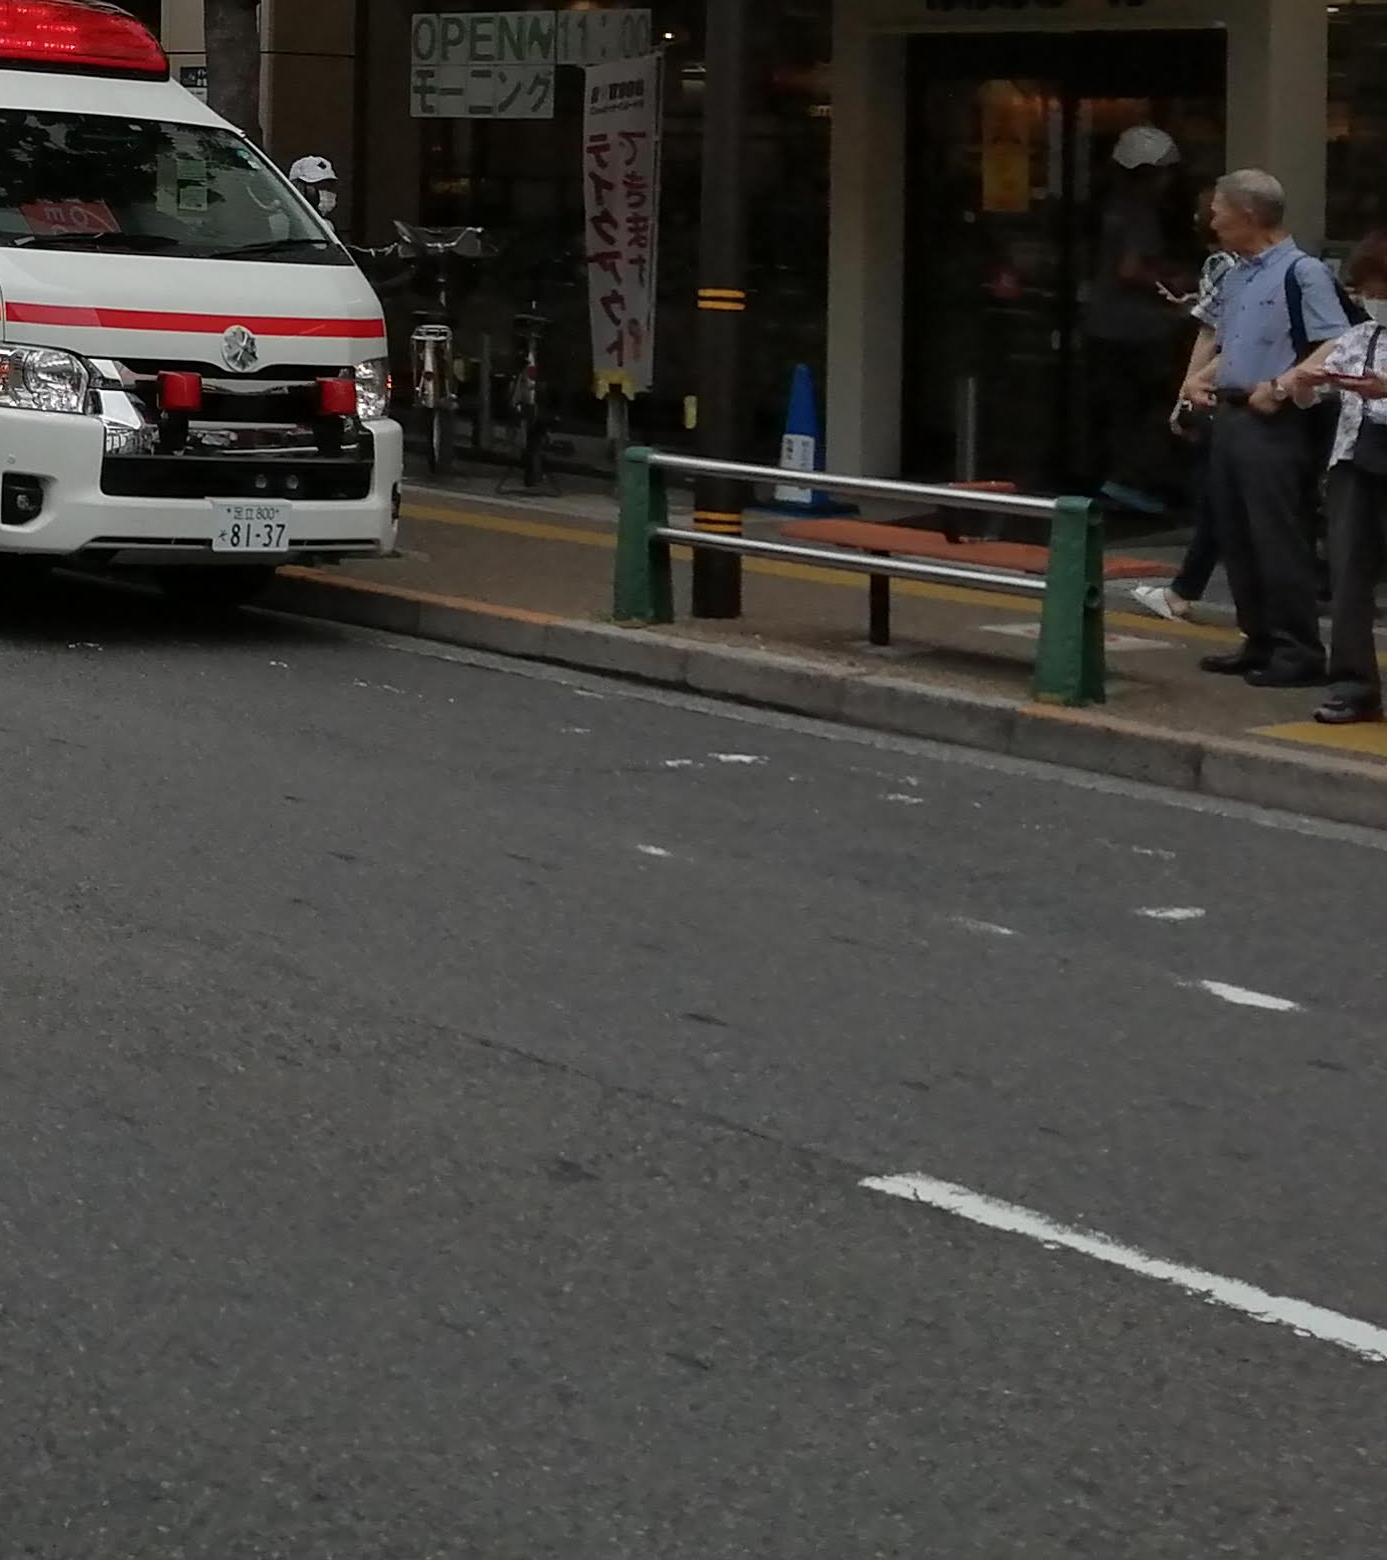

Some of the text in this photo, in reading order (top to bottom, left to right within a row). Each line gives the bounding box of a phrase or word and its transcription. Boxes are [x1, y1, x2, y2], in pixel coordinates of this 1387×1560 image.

[411, 68, 553, 115] モーニング
[256, 507, 275, 520] 800
[230, 523, 286, 547] 81-37
